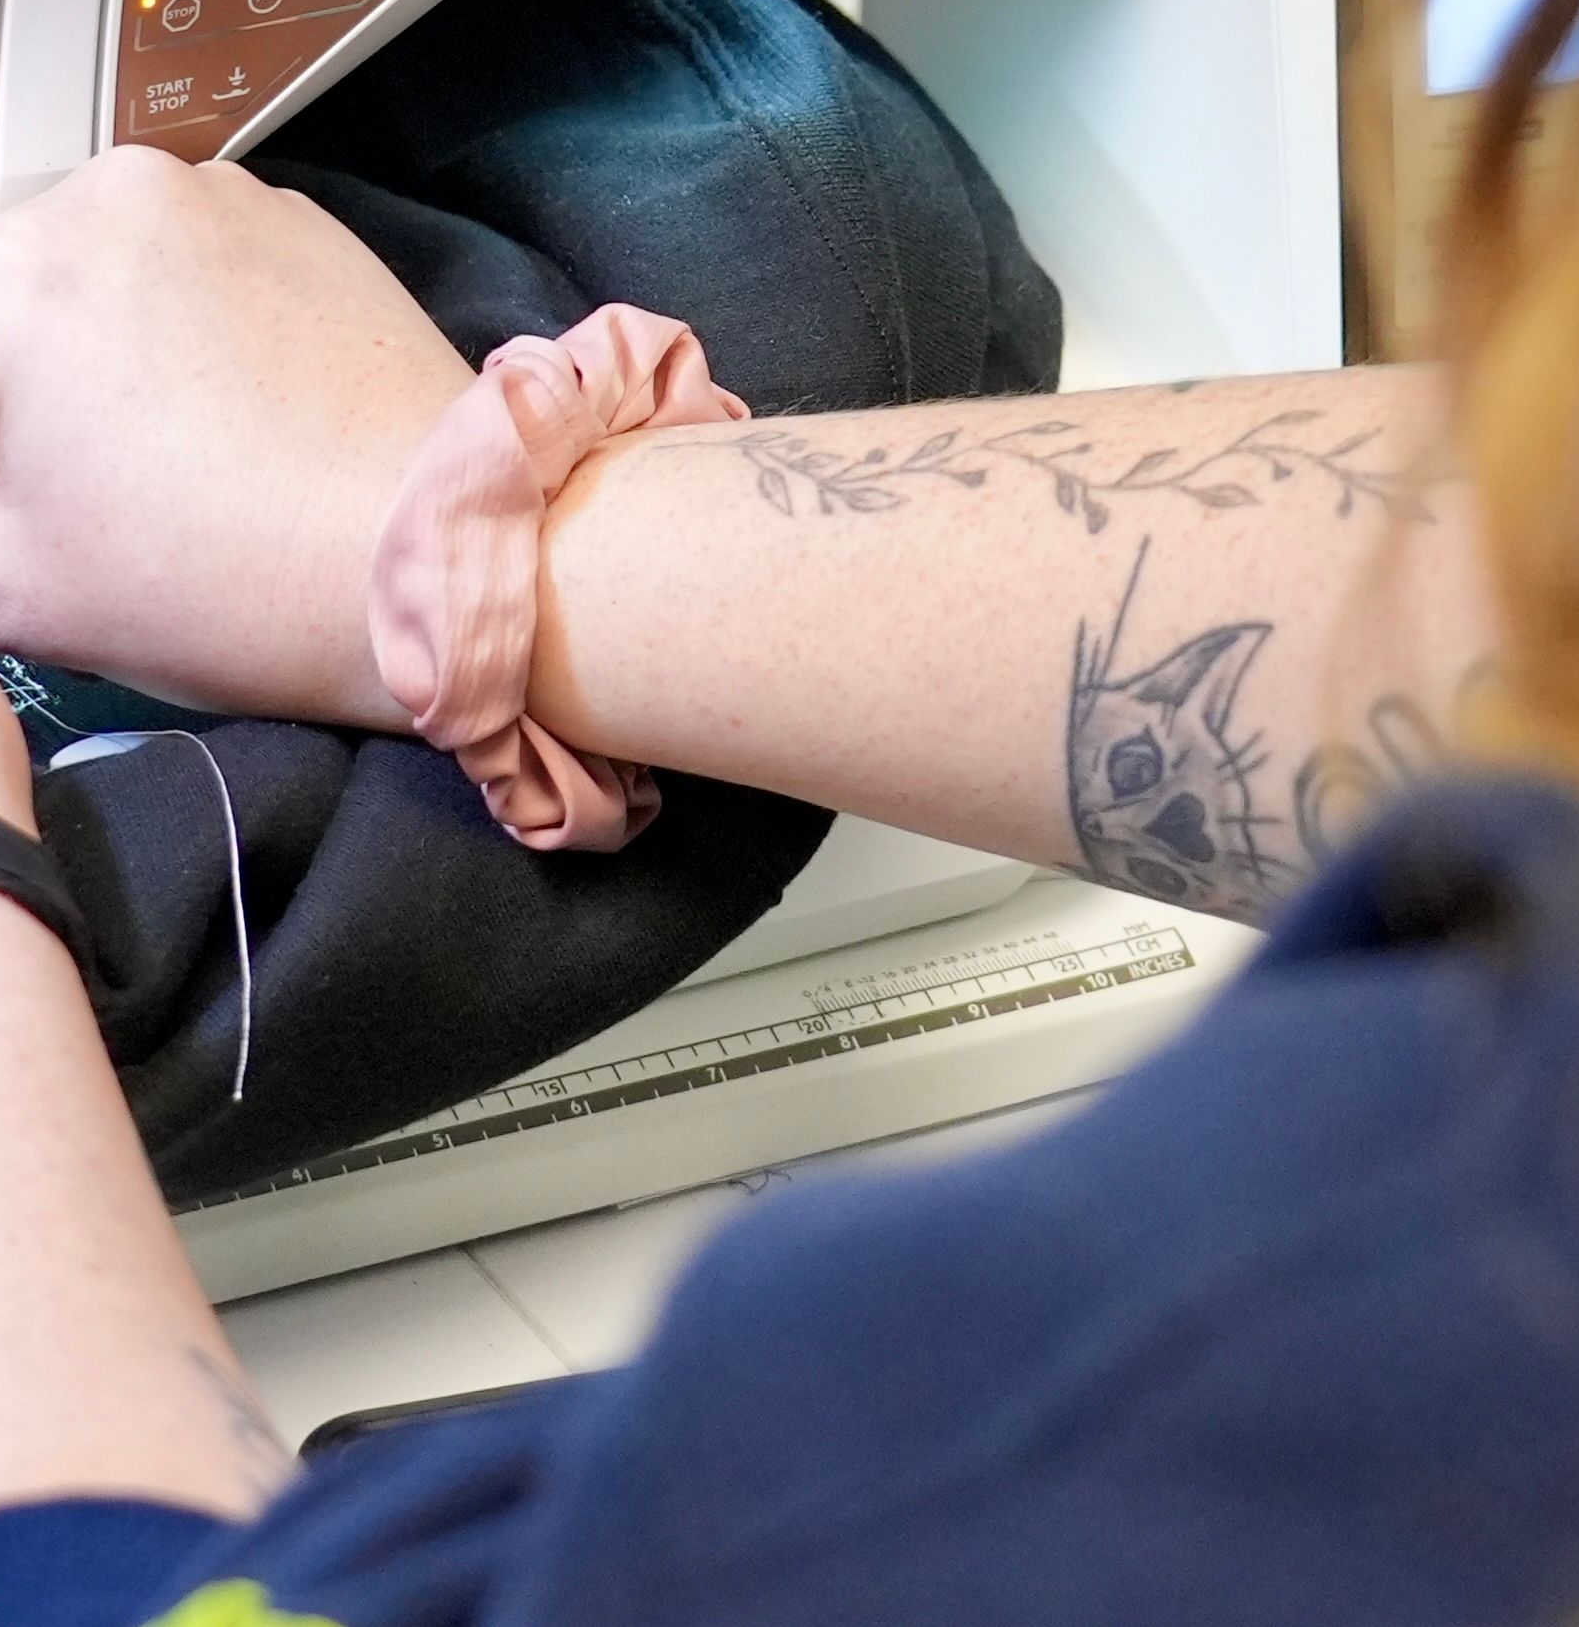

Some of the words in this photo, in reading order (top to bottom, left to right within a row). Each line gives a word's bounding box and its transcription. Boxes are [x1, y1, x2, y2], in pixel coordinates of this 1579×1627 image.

[167, 5, 196, 20] STOP
[147, 77, 195, 98] START
[148, 95, 189, 114] STOP
[1123, 921, 1151, 936] MM
[538, 1082, 561, 1097] 15
[802, 1020, 824, 1034] 20
[1057, 958, 1078, 972] 25
[1136, 938, 1162, 952] CM
[432, 1134, 444, 1148] 5
[570, 1100, 582, 1114] 6
[705, 1067, 717, 1081] 7
[839, 1035, 852, 1049] 8
[967, 1003, 980, 1017] 9
[1085, 972, 1109, 988] 10
[1128, 952, 1186, 979] INCHES
